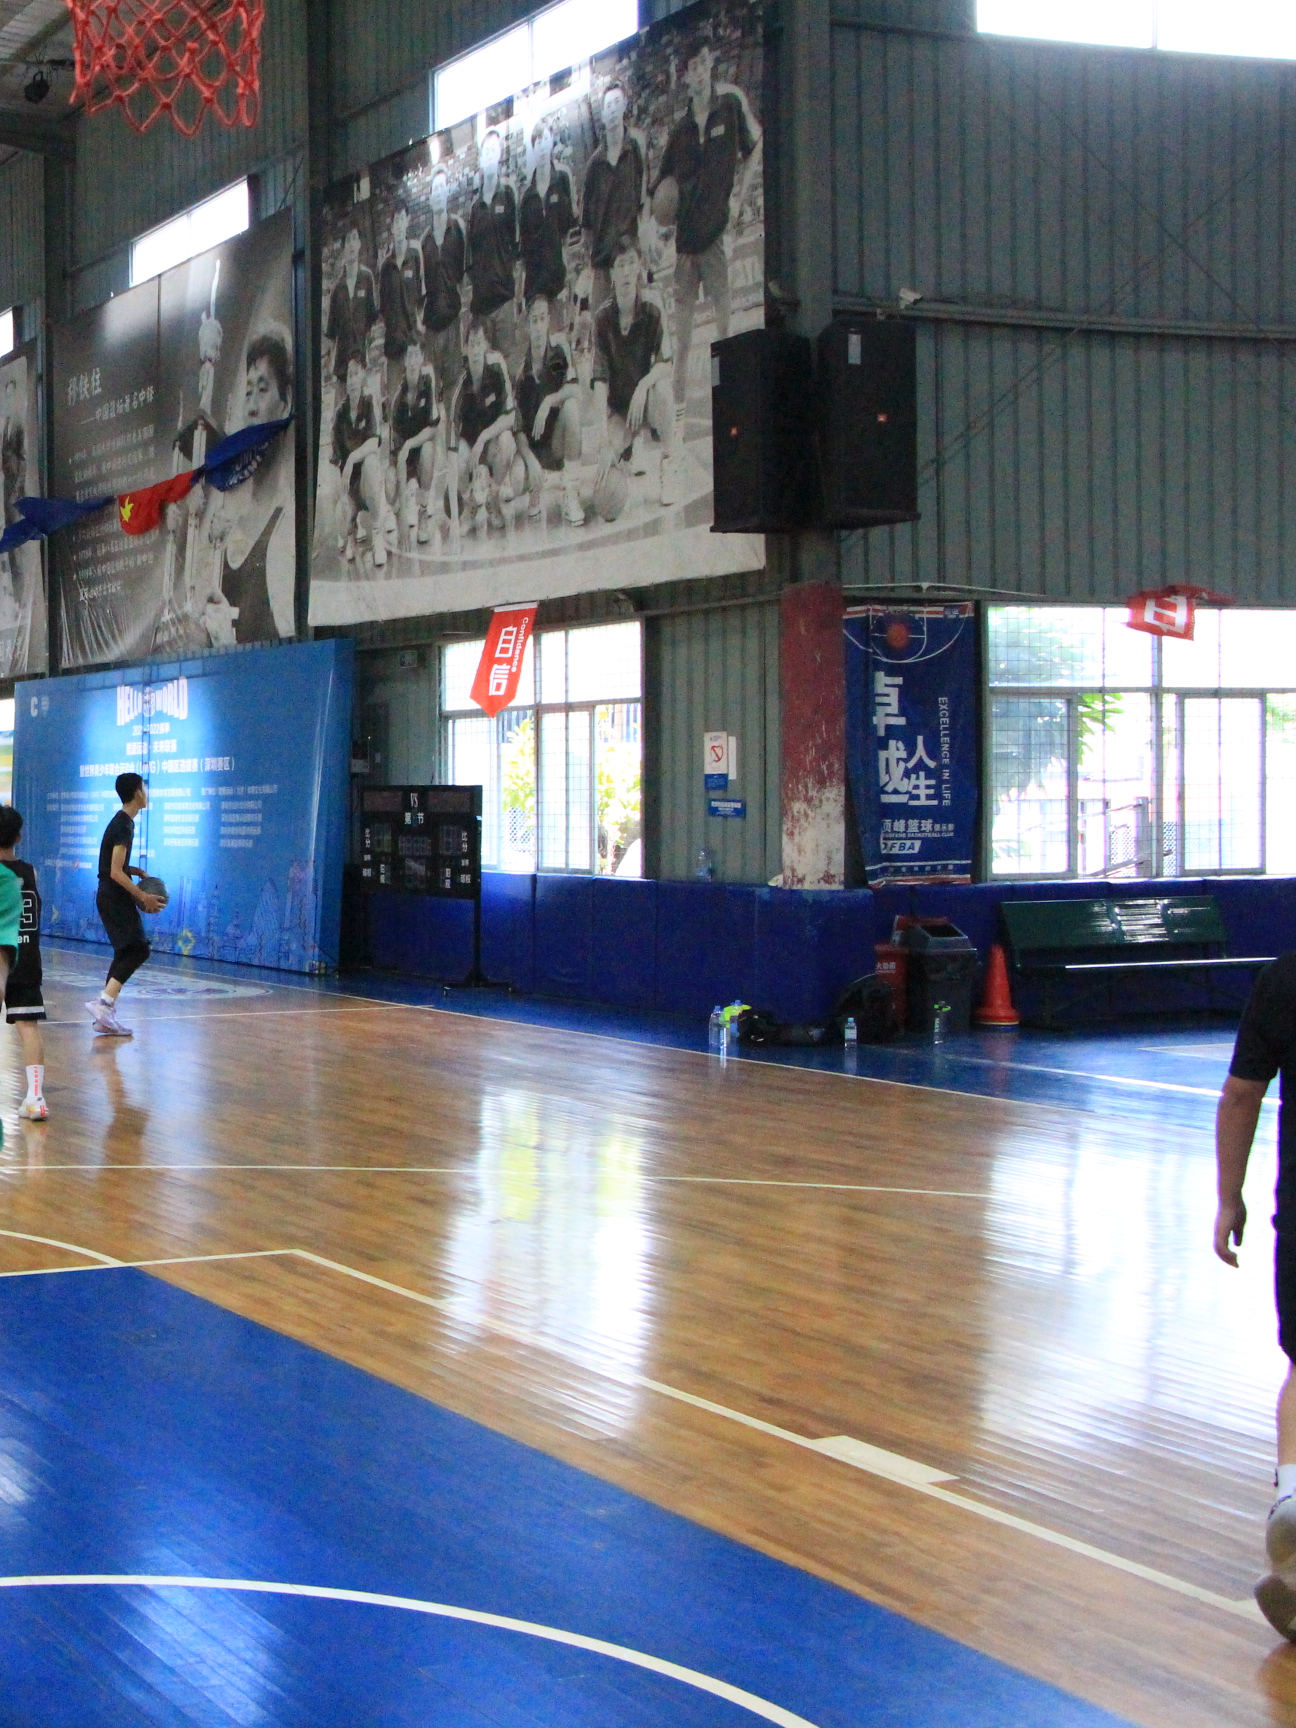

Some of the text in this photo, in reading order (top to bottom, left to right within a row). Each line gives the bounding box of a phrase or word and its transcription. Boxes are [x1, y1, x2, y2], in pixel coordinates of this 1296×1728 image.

[489, 625, 518, 696] 自信
[906, 735, 939, 806] 人生
[938, 697, 951, 806] EXCELLENCE IN LIFE
[410, 792, 419, 808] VS
